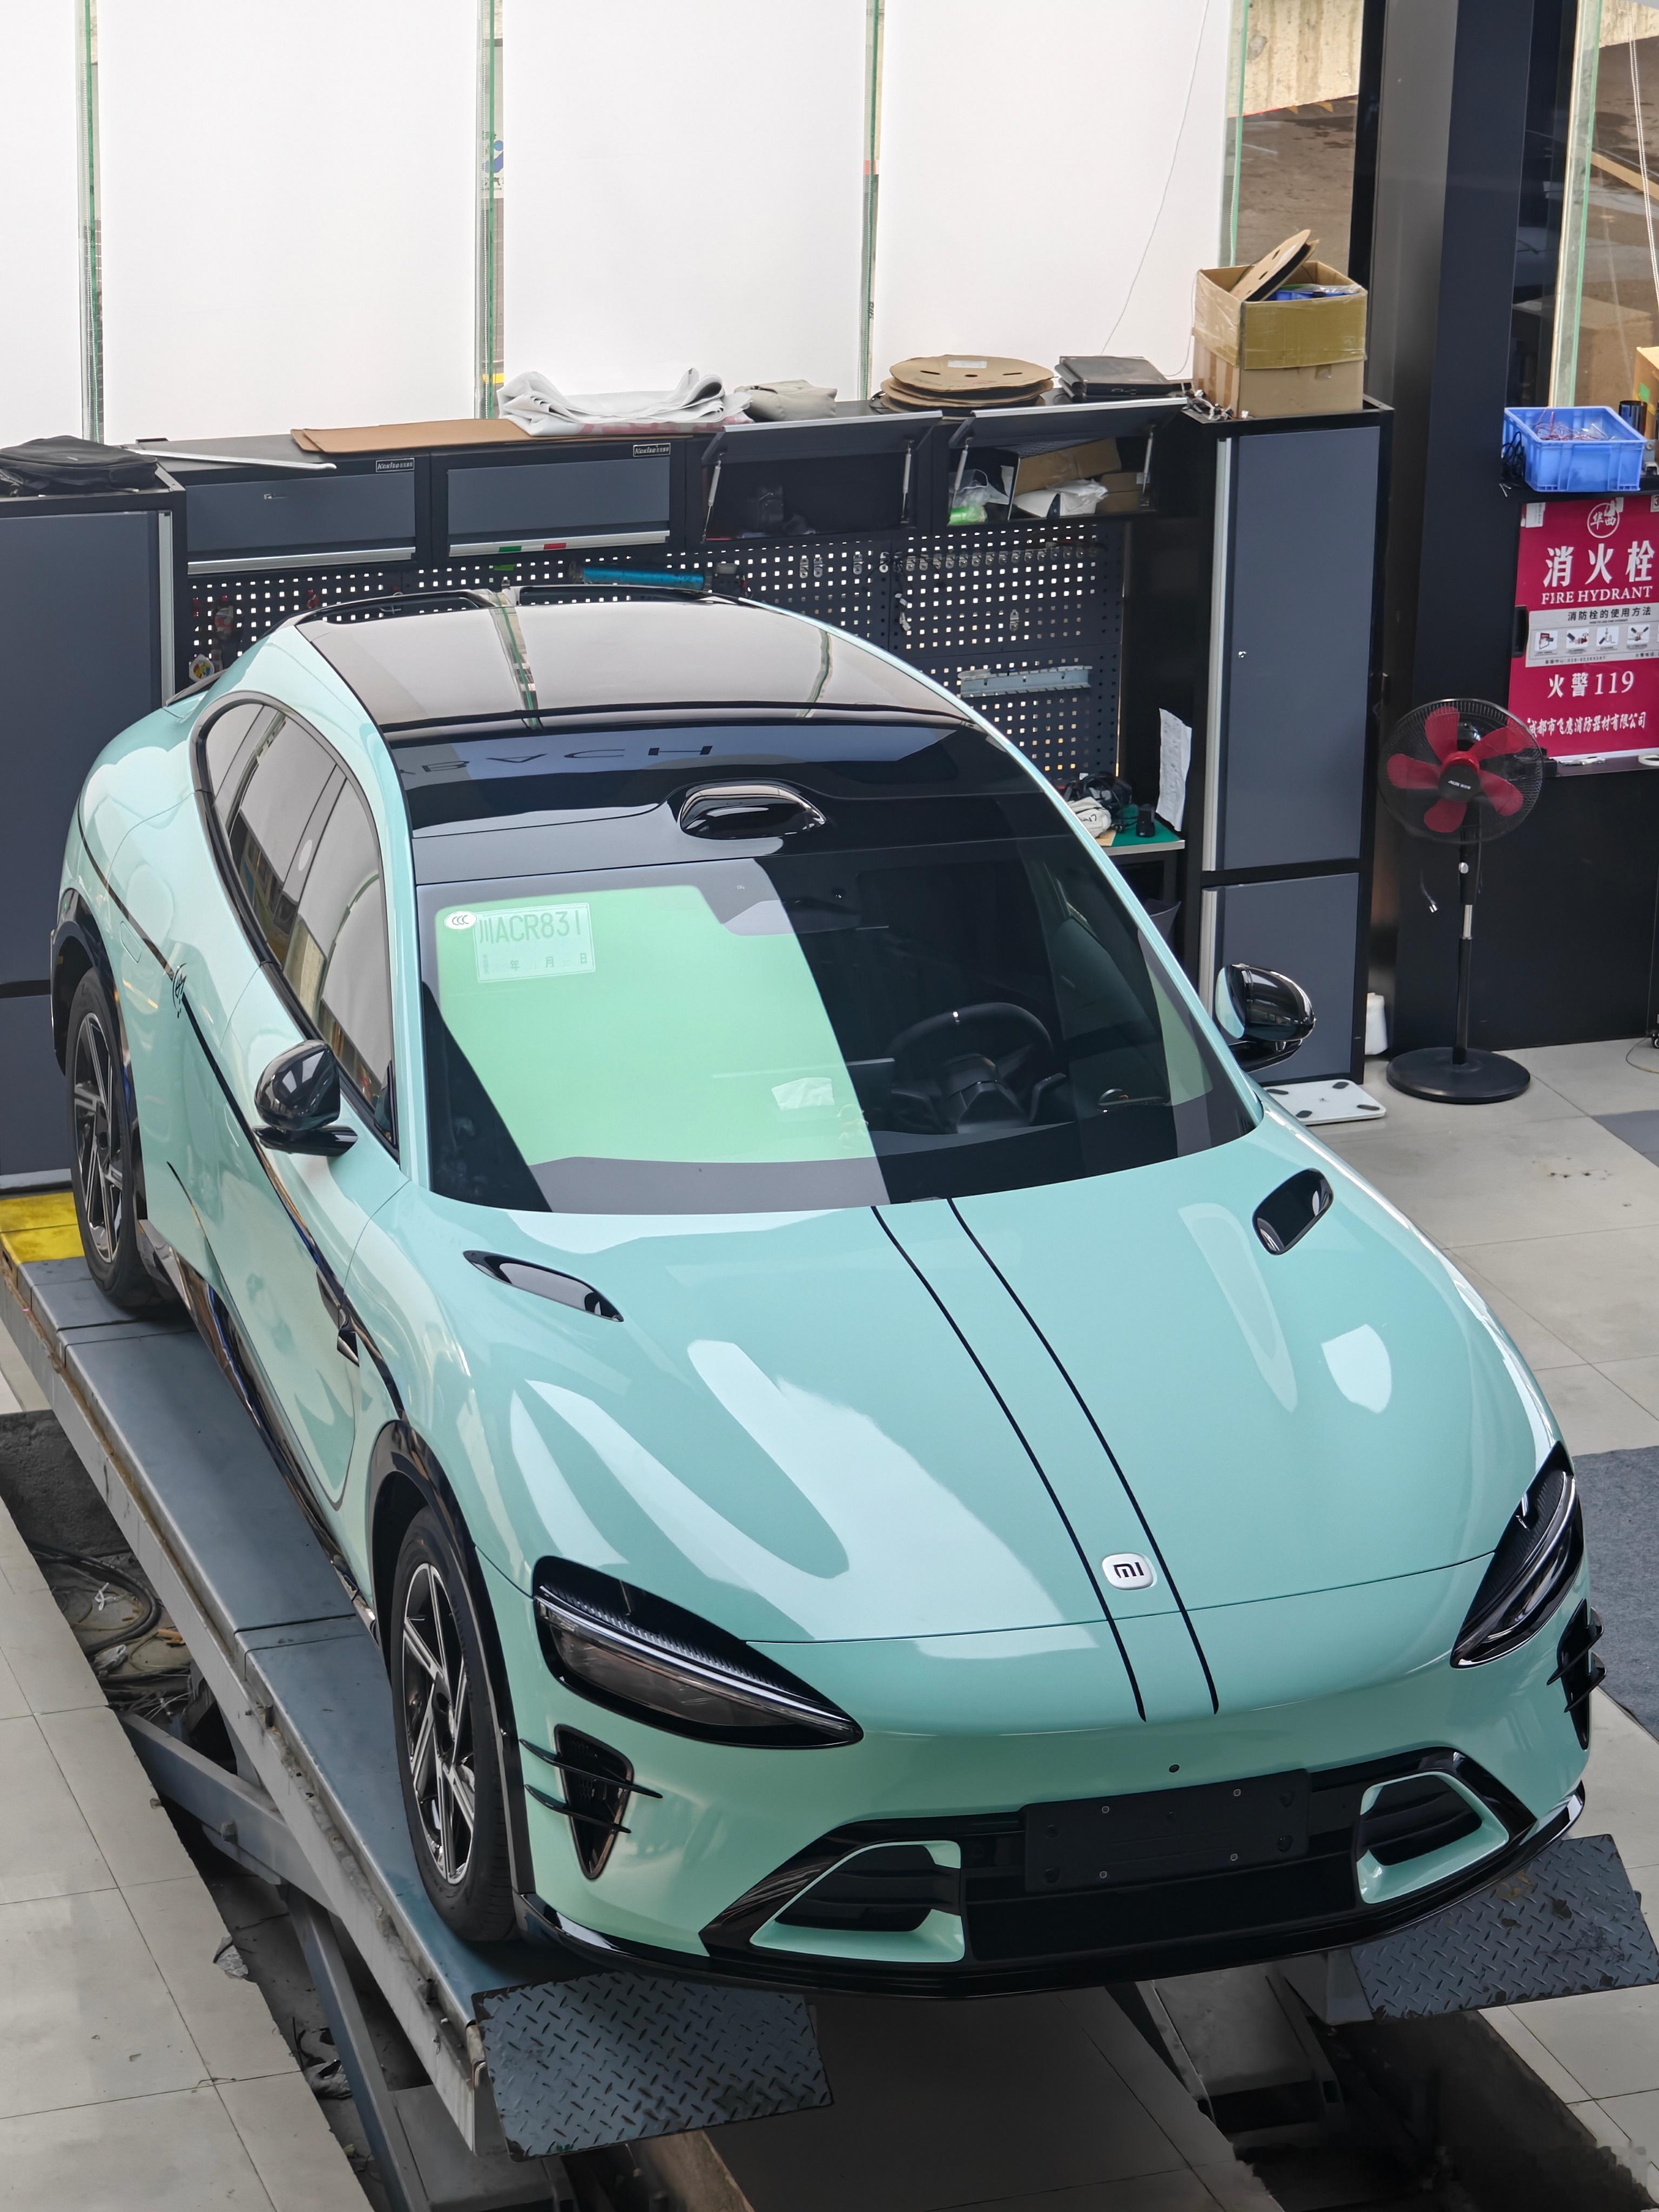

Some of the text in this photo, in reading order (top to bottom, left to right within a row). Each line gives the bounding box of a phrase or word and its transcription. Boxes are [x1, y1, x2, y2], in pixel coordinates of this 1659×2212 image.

[1543, 541, 1655, 588] 消火栓
[1541, 586, 1653, 605] FIRE HYDRANT
[1568, 606, 1651, 621] 消防栓的使用方法
[510, 953, 588, 971] 年 月 日
